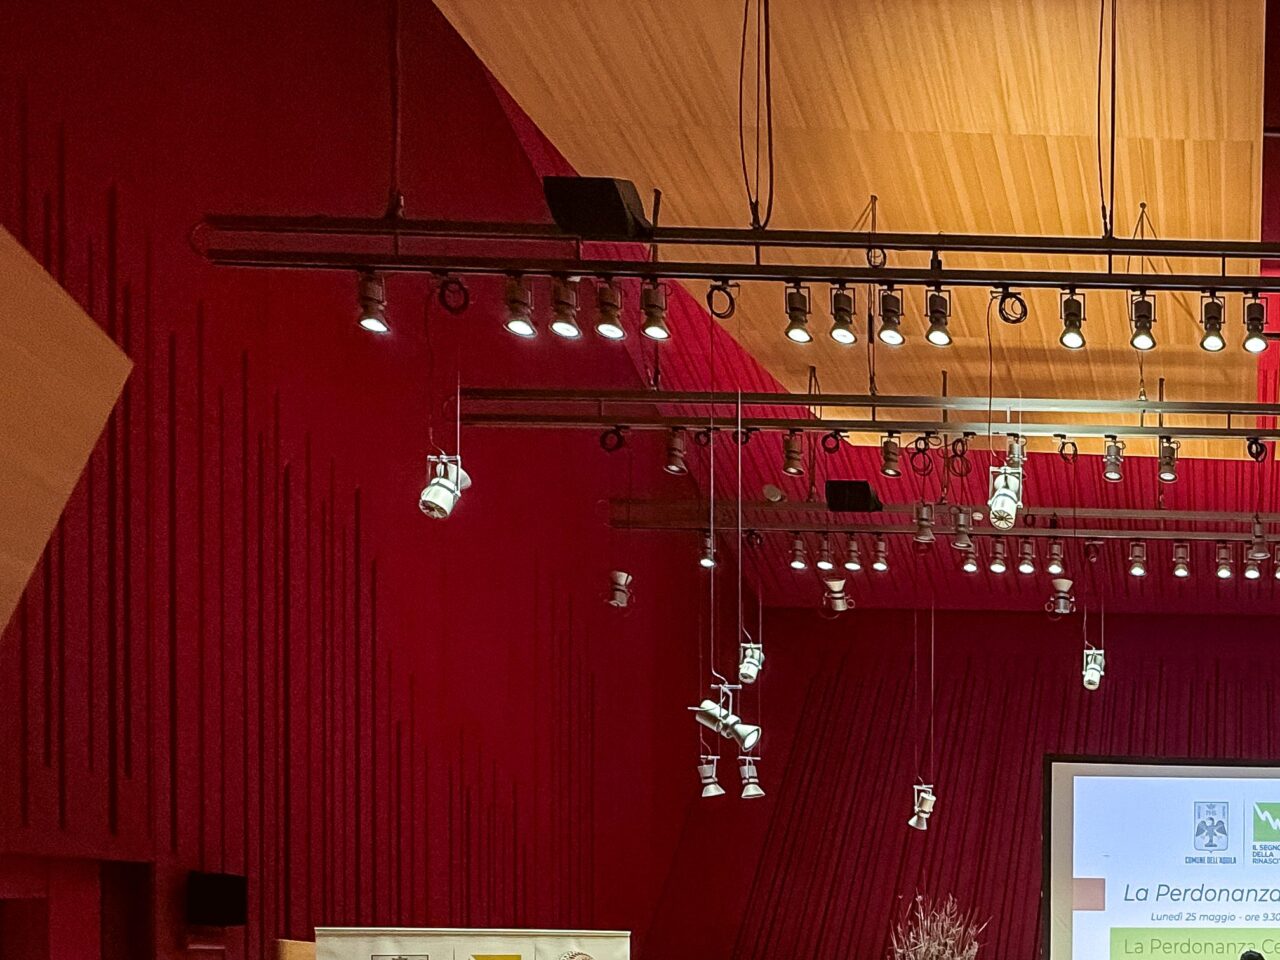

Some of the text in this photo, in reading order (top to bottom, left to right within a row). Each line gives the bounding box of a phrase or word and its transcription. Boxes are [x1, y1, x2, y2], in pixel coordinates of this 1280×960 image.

[1124, 884, 1149, 902] La
[1151, 912, 1182, 921] Lunedì
[1186, 912, 1196, 921] 25
[1199, 912, 1236, 923] maggio
[1124, 939, 1144, 954] La
